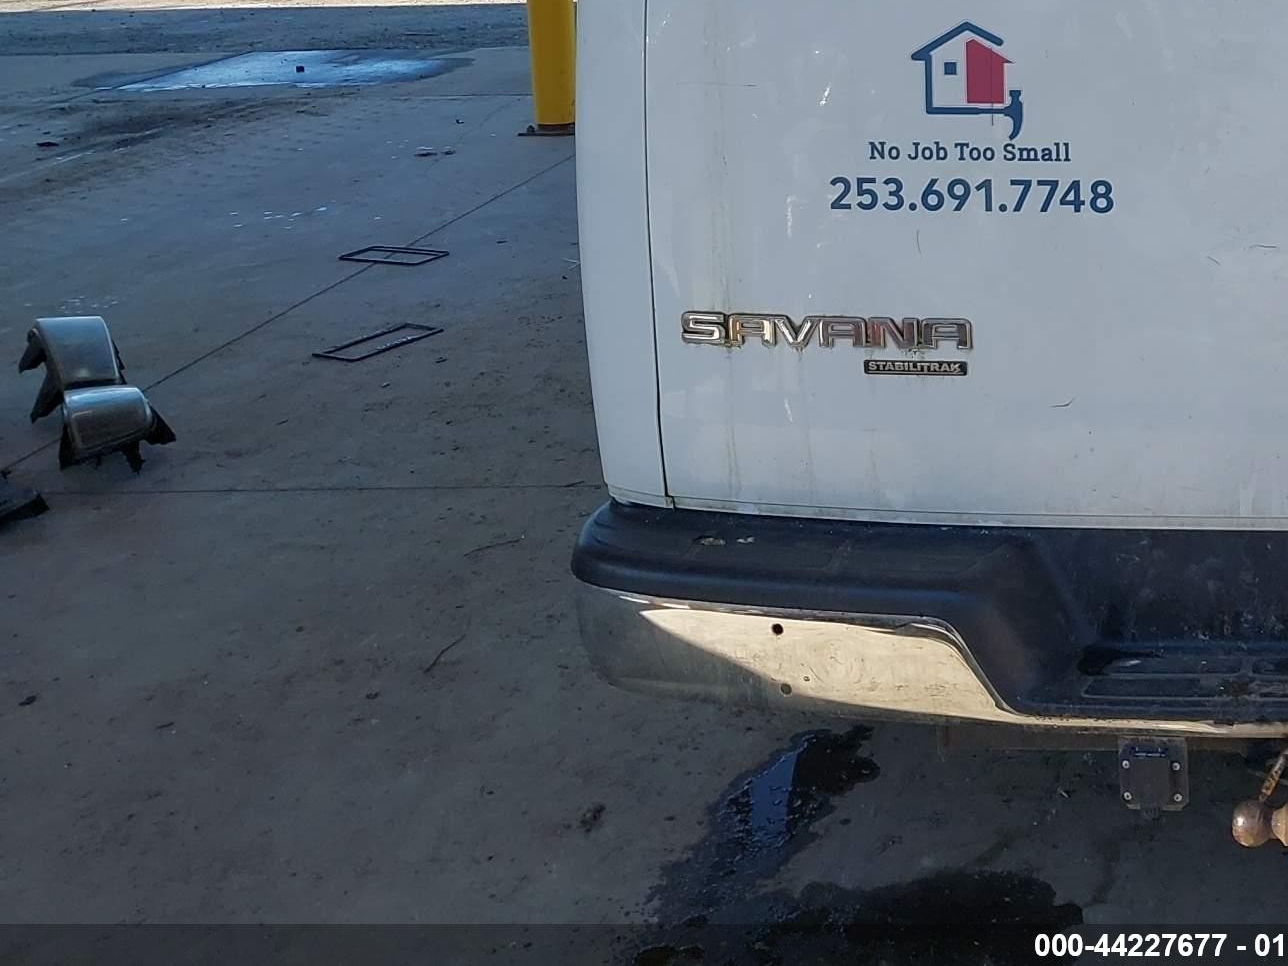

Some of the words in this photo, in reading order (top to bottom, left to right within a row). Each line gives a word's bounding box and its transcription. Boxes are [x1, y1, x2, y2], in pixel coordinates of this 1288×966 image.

[869, 142, 900, 160] No
[908, 142, 948, 160] Job
[954, 143, 995, 161] Too
[1003, 143, 1071, 162] Small
[829, 176, 1114, 213] 253.691.7748
[681, 311, 972, 350] SAVANA
[868, 361, 961, 374] STABILITRAK
